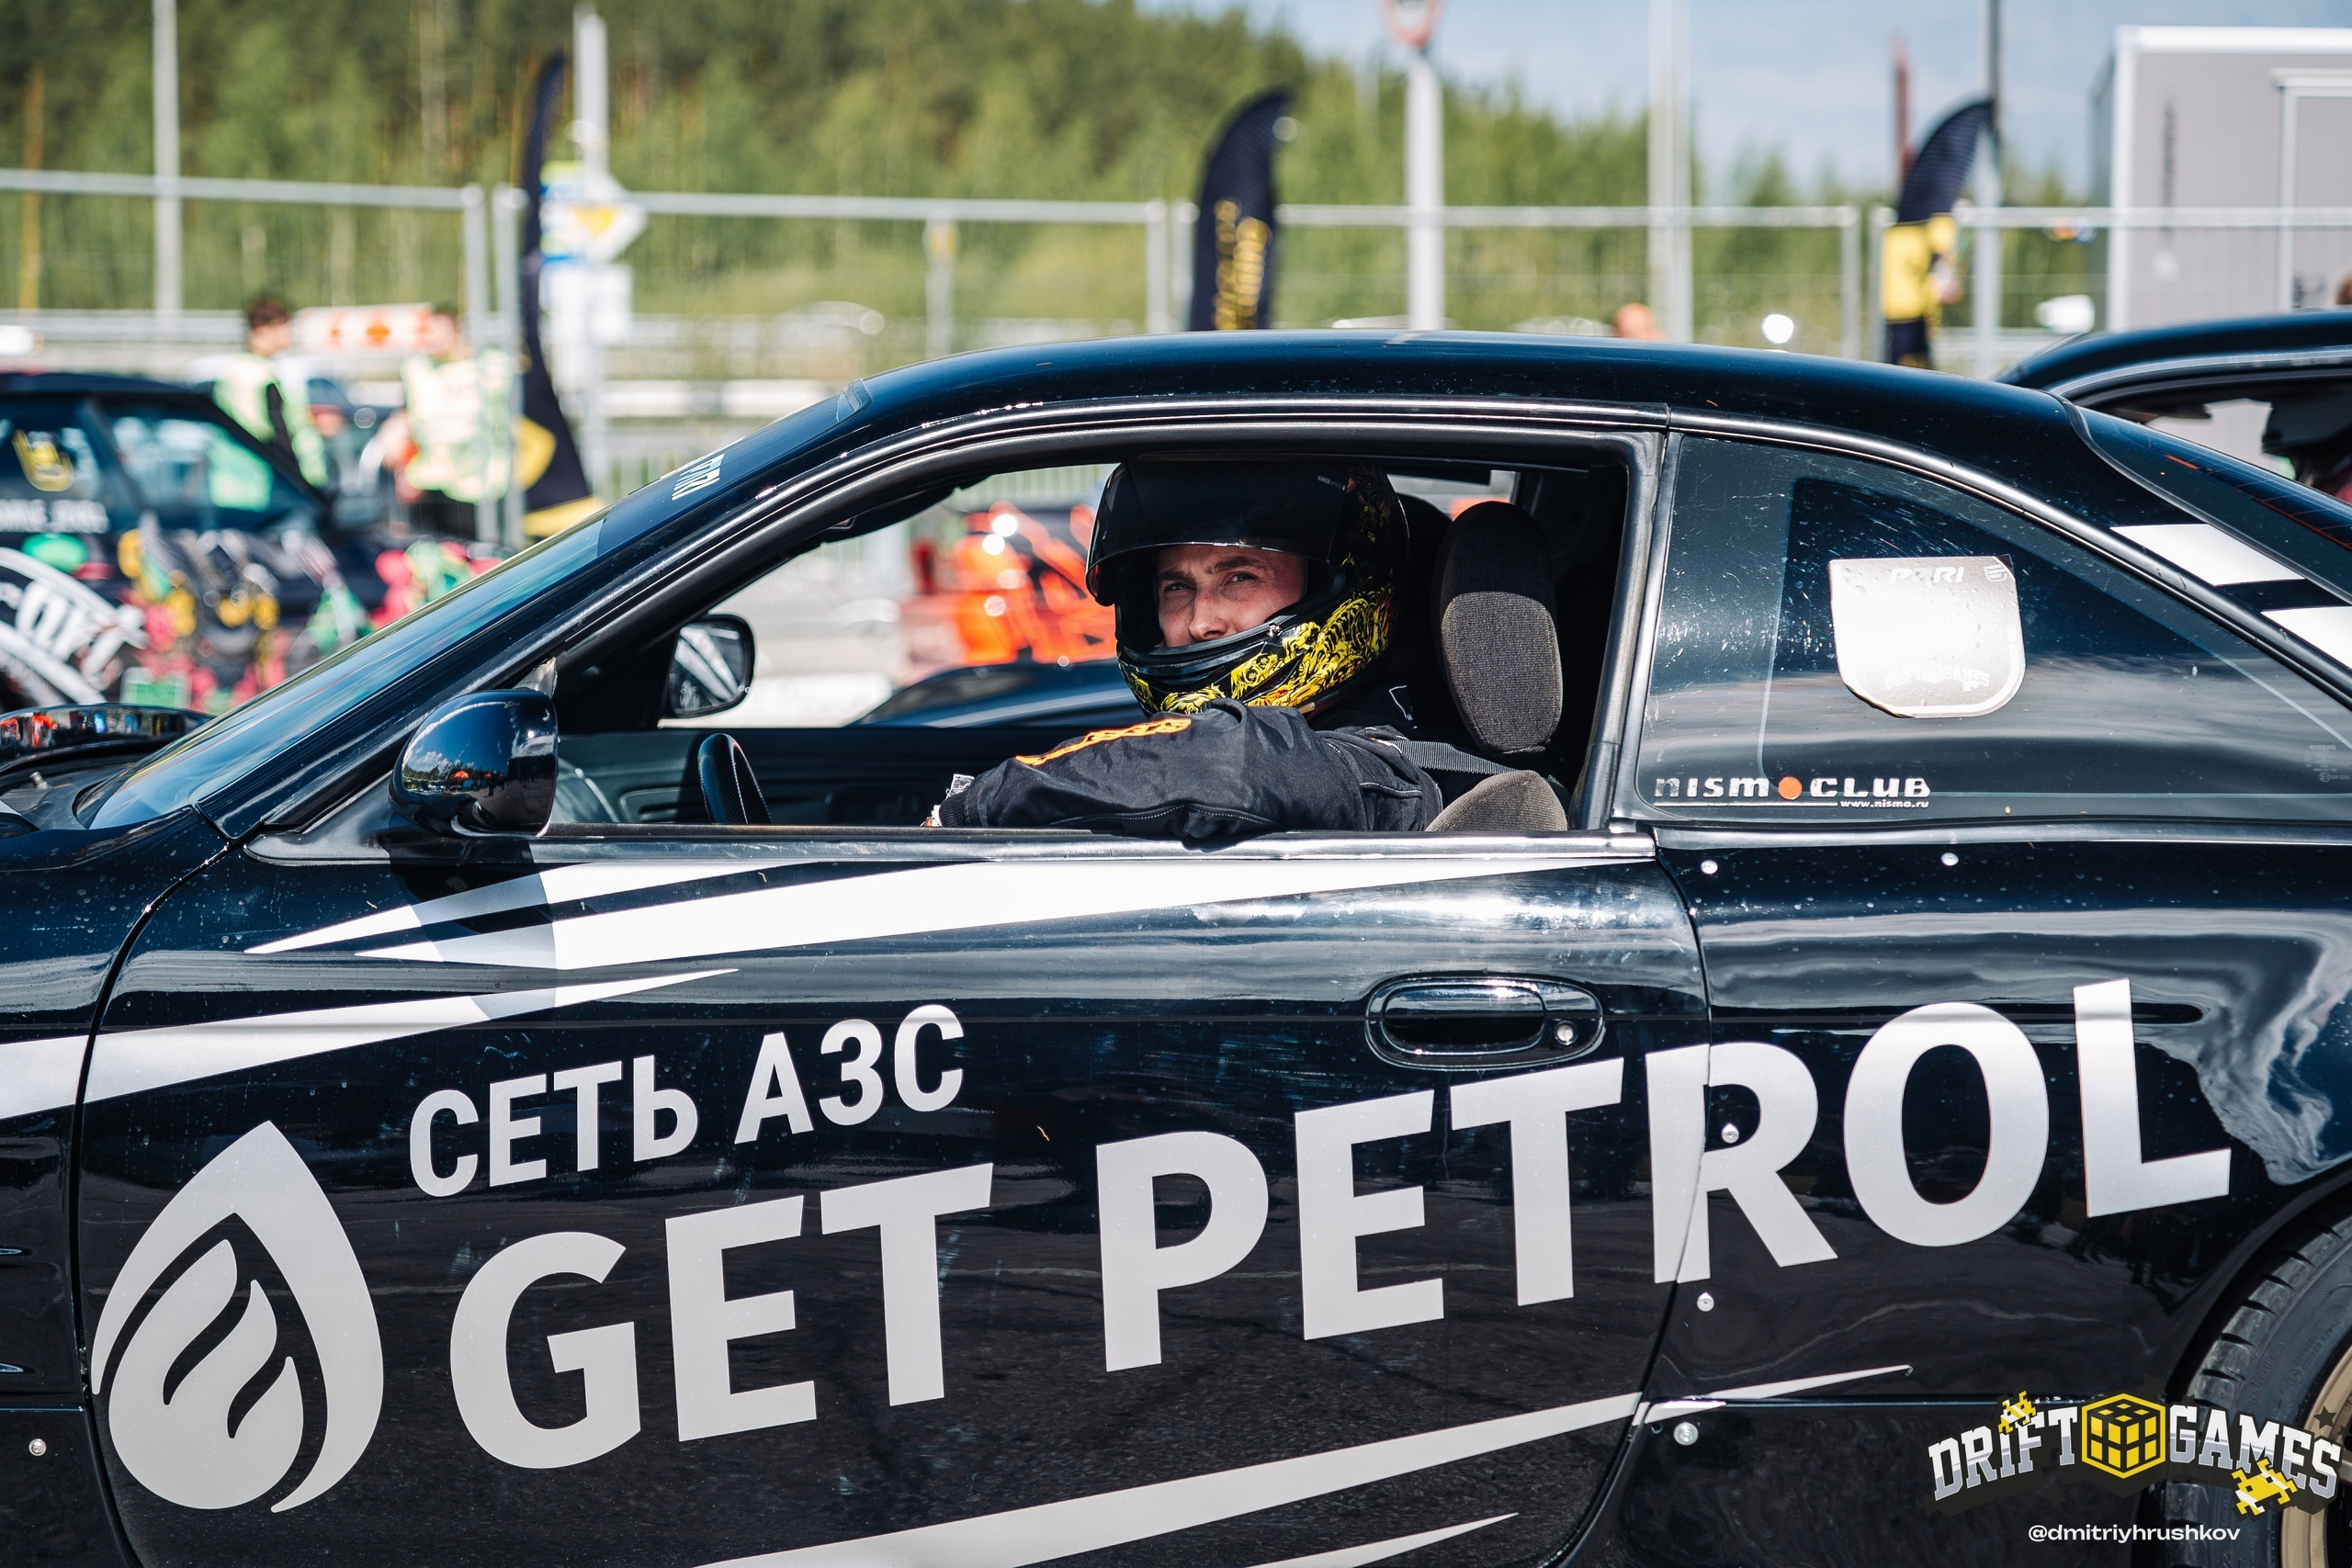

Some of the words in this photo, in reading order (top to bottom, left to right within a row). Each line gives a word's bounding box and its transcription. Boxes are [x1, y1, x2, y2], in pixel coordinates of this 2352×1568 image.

[1889, 567, 1964, 584] PARI
[1840, 799, 1929, 808] www.nismo.ru
[409, 1055, 699, 1197] СЕТЬ
[734, 1004, 964, 1145] АЗС
[450, 1162, 993, 1469] GET
[1096, 978, 2233, 1372] PETROL
